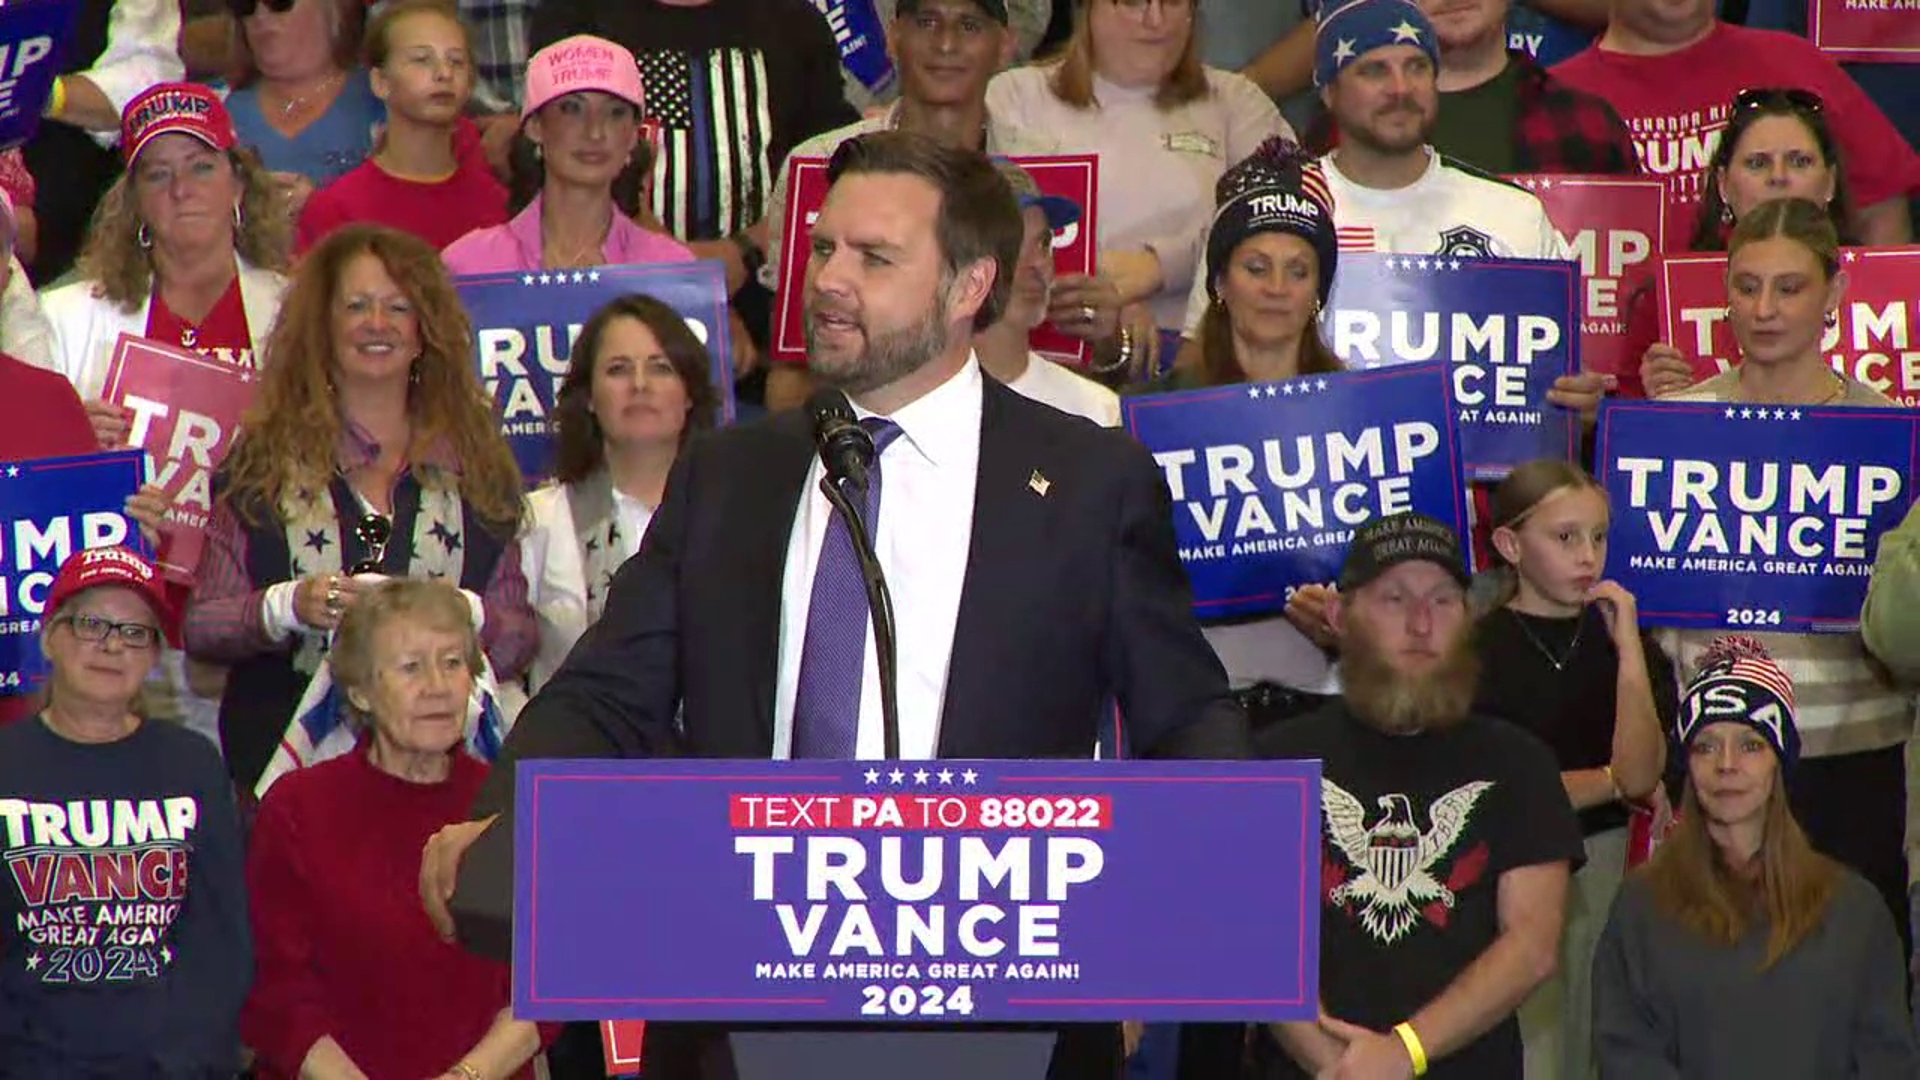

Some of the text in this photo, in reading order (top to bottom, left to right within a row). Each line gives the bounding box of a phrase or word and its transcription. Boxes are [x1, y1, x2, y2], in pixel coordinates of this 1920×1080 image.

[549, 47, 614, 66] WOMEN
[1248, 194, 1319, 217] TRUMP
[1457, 410, 1542, 425] AT AGAIN!
[1152, 421, 1440, 501] TRUMP
[1617, 457, 1902, 516] TRUMP
[1188, 476, 1413, 541] VANCE
[1179, 544, 1226, 562] MAKE
[1231, 535, 1308, 556] AMERICA
[1647, 510, 1868, 559] VANCE
[83, 549, 154, 580] Trump
[1630, 556, 1676, 571] MAKE
[1682, 558, 1758, 574] AMERICA
[1763, 561, 1818, 576] GREAT
[1726, 608, 1782, 626] 2024
[1677, 685, 1785, 752] USA
[0, 797, 197, 849] TRUMP
[740, 797, 1101, 828] TEXT PA TO 88022
[9, 848, 189, 908] VANCE
[734, 836, 1105, 901] TRUMP
[17, 905, 86, 932] MAKE
[774, 903, 1061, 957] VANCE
[28, 925, 99, 947] GREAT
[42, 946, 159, 983] 2024
[755, 963, 1080, 979] MAKE AMERICA GREAT AGAIN!
[860, 984, 974, 1016] 2024
